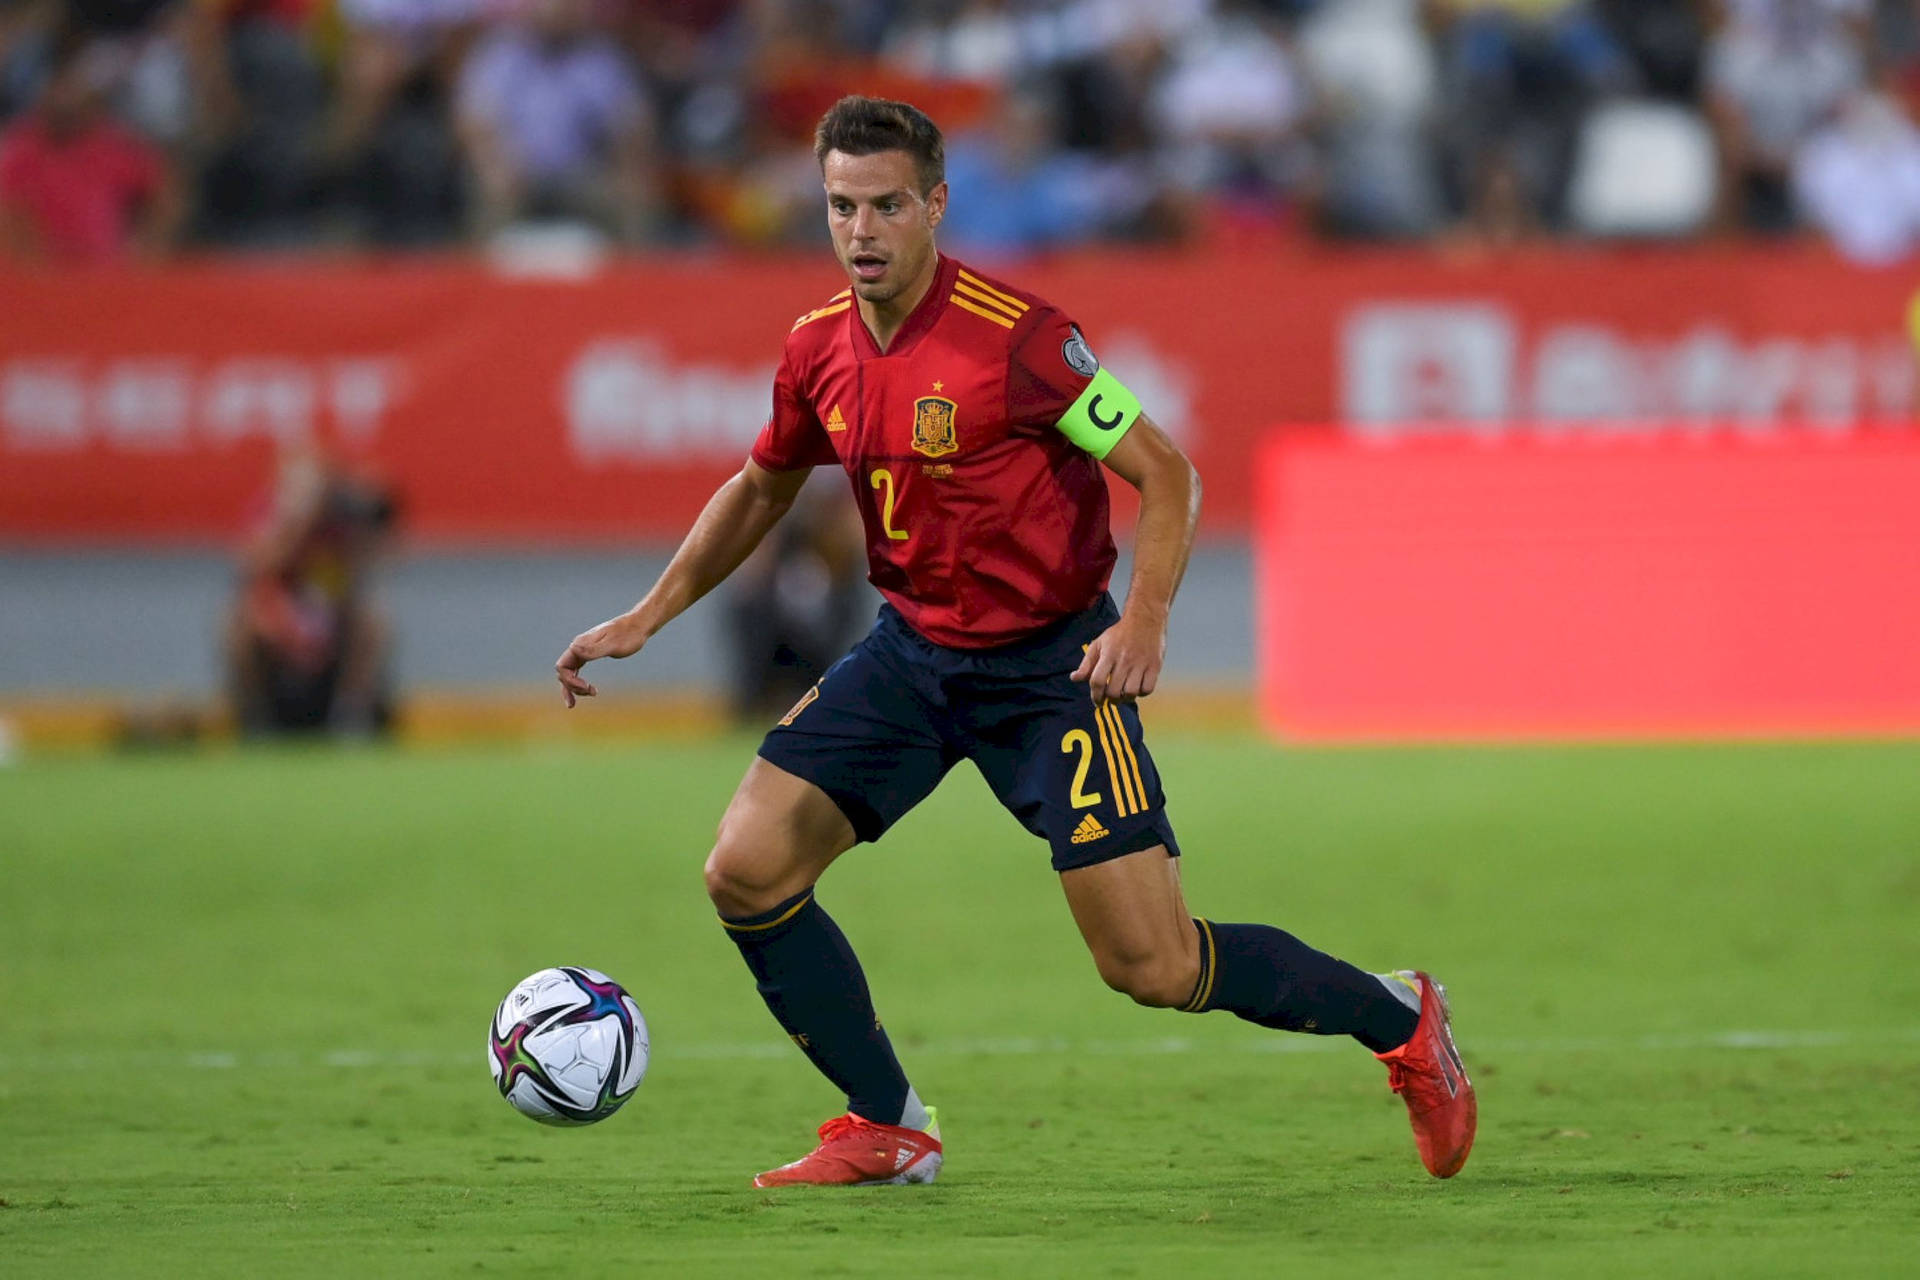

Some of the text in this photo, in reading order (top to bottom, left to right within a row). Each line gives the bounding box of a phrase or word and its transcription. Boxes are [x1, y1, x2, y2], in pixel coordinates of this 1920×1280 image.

[1088, 393, 1123, 431] C
[871, 469, 909, 539] 2
[1061, 729, 1101, 809] 2
[1071, 829, 1110, 844] adidas
